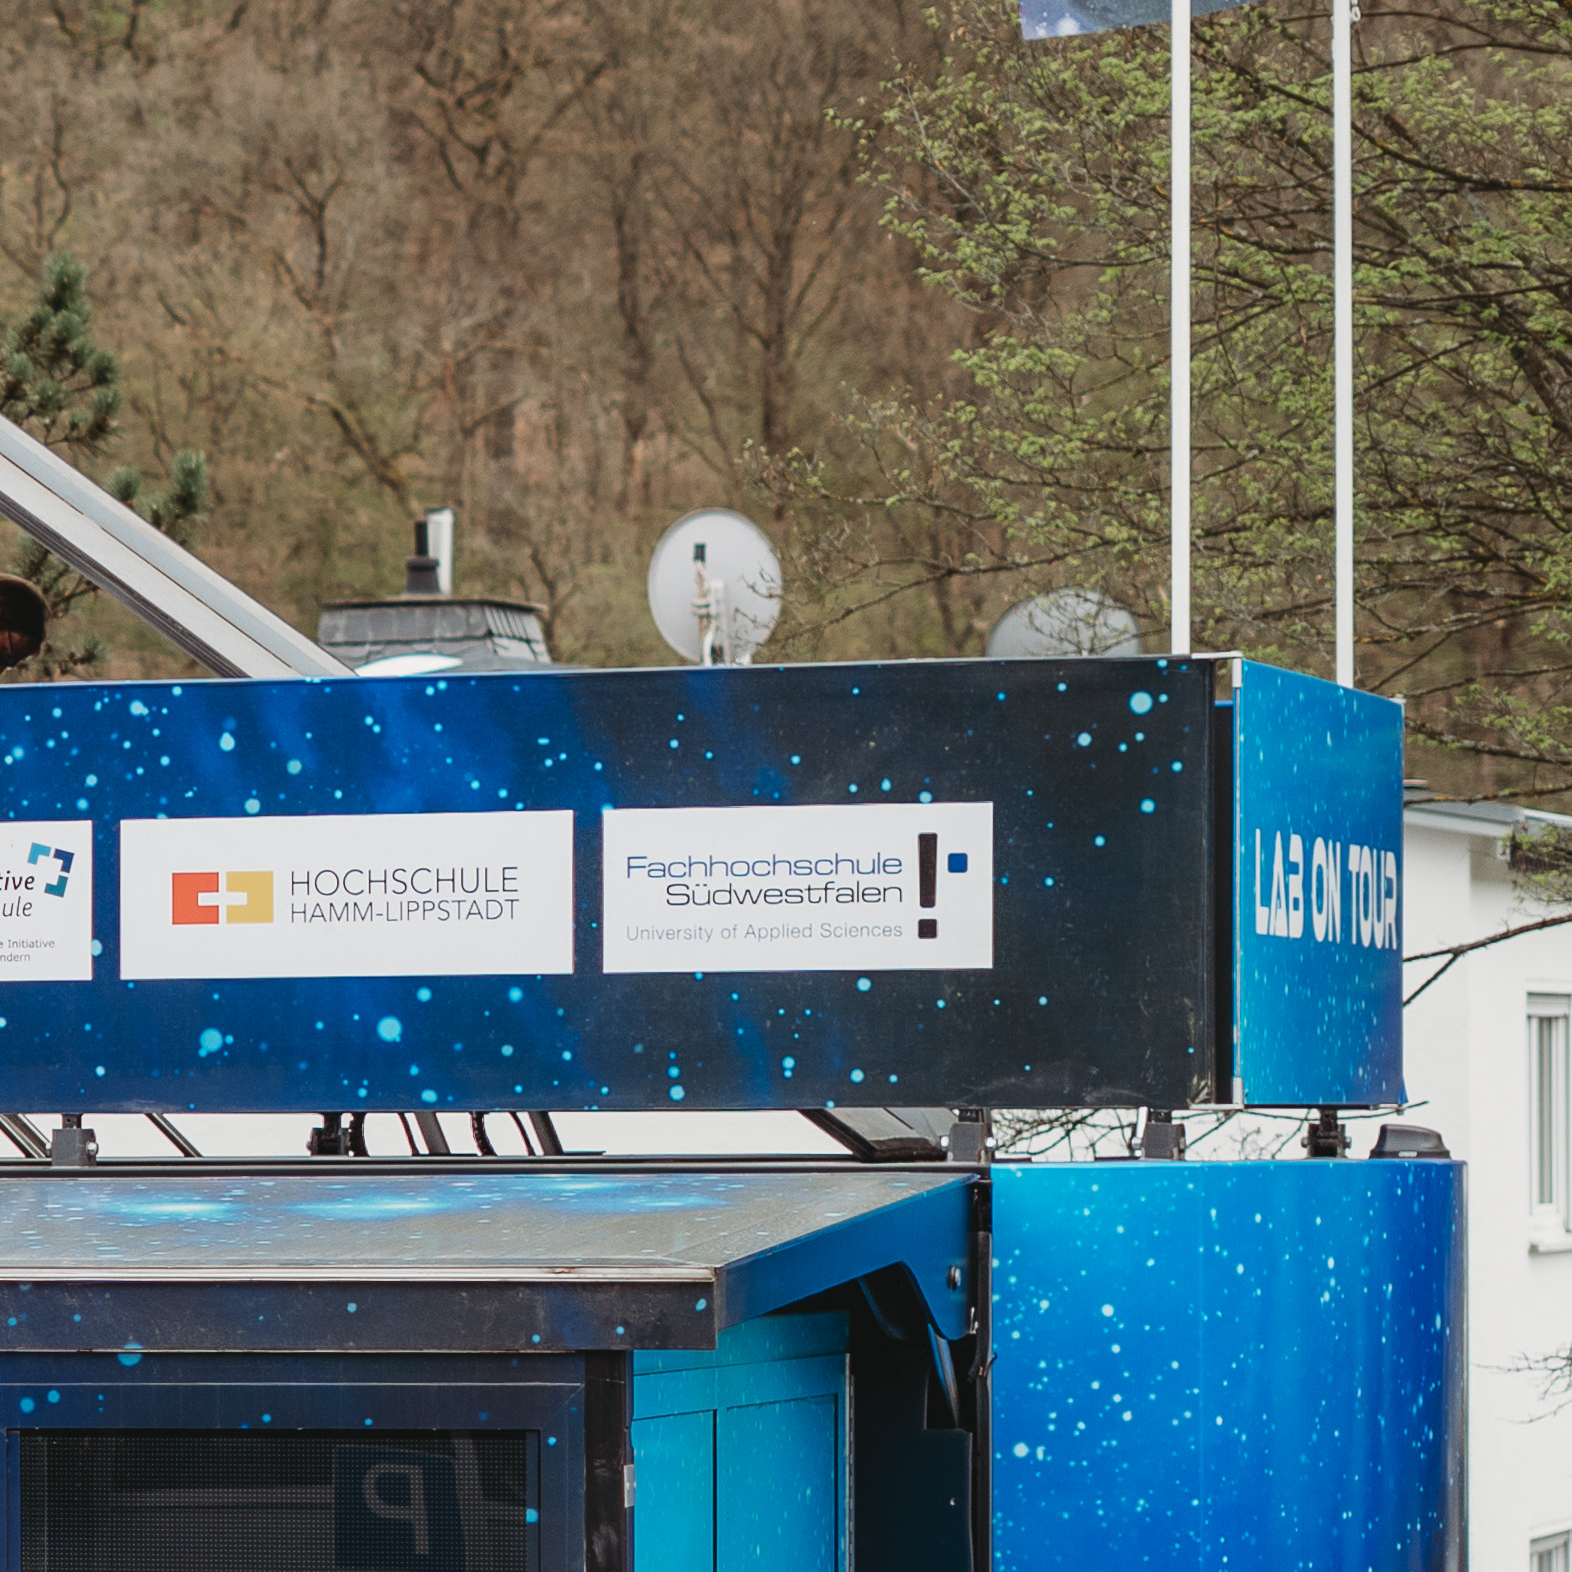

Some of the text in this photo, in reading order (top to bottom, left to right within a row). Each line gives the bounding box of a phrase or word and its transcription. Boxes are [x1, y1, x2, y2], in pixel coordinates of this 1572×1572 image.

[626, 852, 903, 879] Fachhochschule
[290, 866, 520, 896] HOCHSCHULE
[666, 881, 903, 907] Südwestfalen
[1254, 828, 1397, 950] LAB ON TOUR
[290, 898, 521, 924] HAMM-LIPPSTADT
[7, 938, 56, 950] Initiative
[626, 921, 903, 943] University of Applied Sciences
